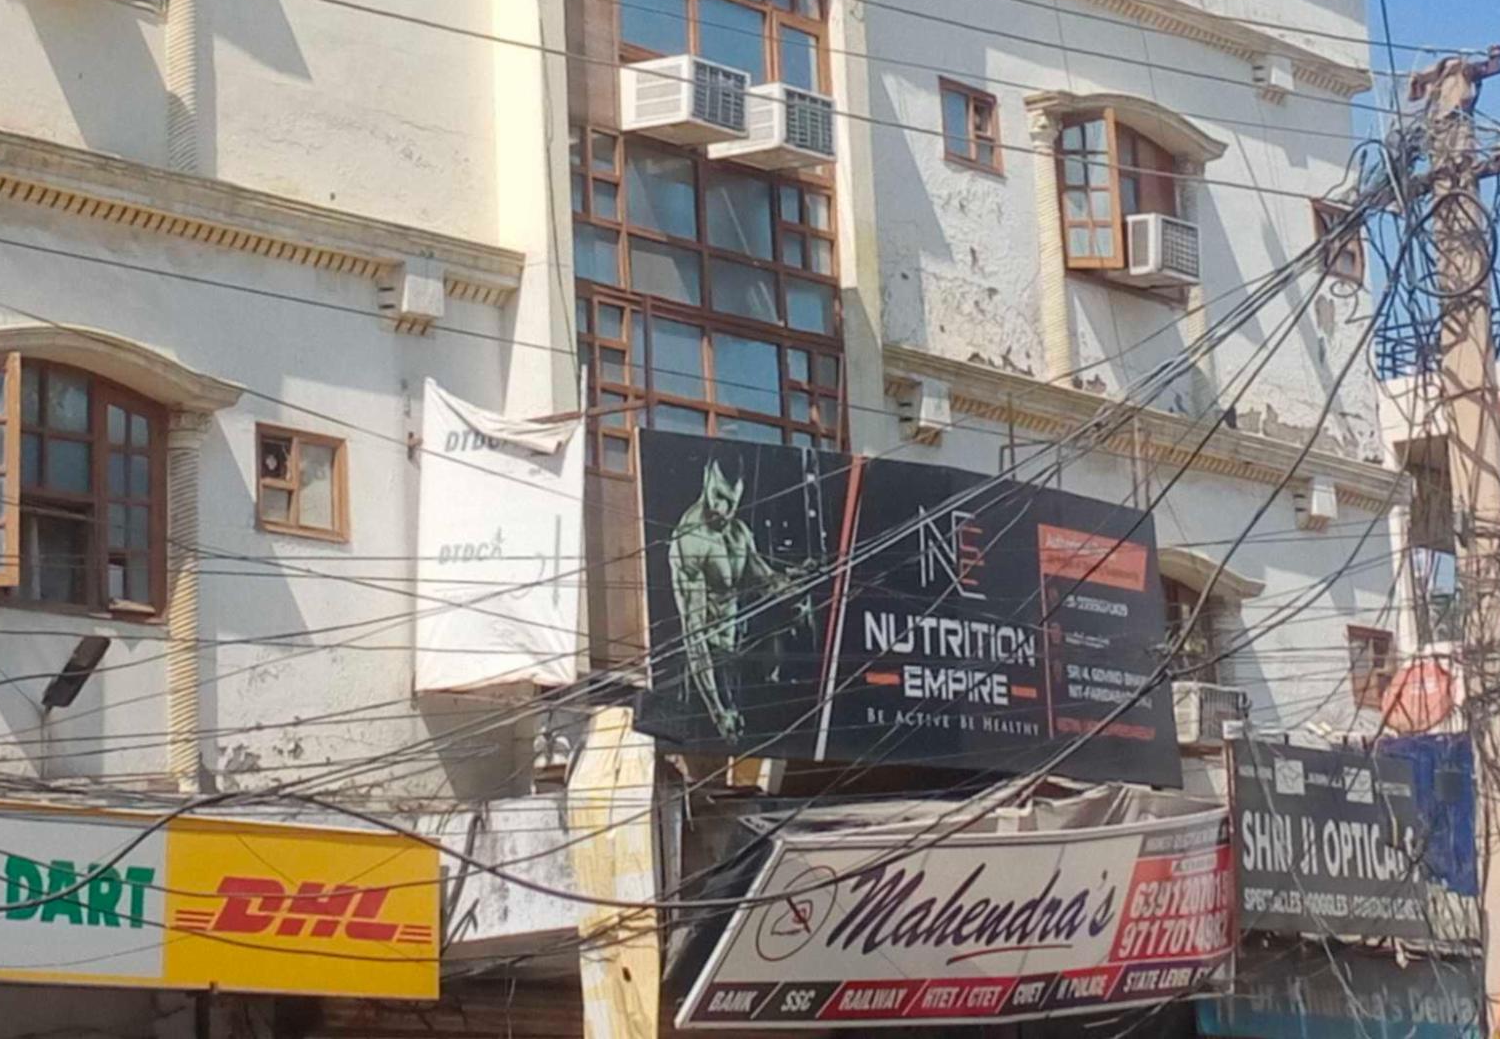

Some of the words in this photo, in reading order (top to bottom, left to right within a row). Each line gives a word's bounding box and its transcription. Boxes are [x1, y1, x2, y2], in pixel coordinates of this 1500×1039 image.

[864, 610, 1036, 667] NUTRITION
[903, 665, 1009, 705] EMPIRE
[867, 708, 884, 724] BE
[896, 711, 950, 729] ACTIVE
[960, 712, 975, 731] BE
[983, 715, 1040, 737] HEALTHY
[1242, 810, 1293, 873] SHRI
[3, 854, 156, 929] DART
[212, 875, 401, 943] DHL
[825, 862, 1116, 955] Mahendra's
[781, 989, 816, 1011] SSC
[837, 987, 909, 1010] RAILWAY
[1122, 969, 1160, 994] STATE
[1159, 967, 1193, 989] LEVEL
[707, 990, 759, 1012] BANK
